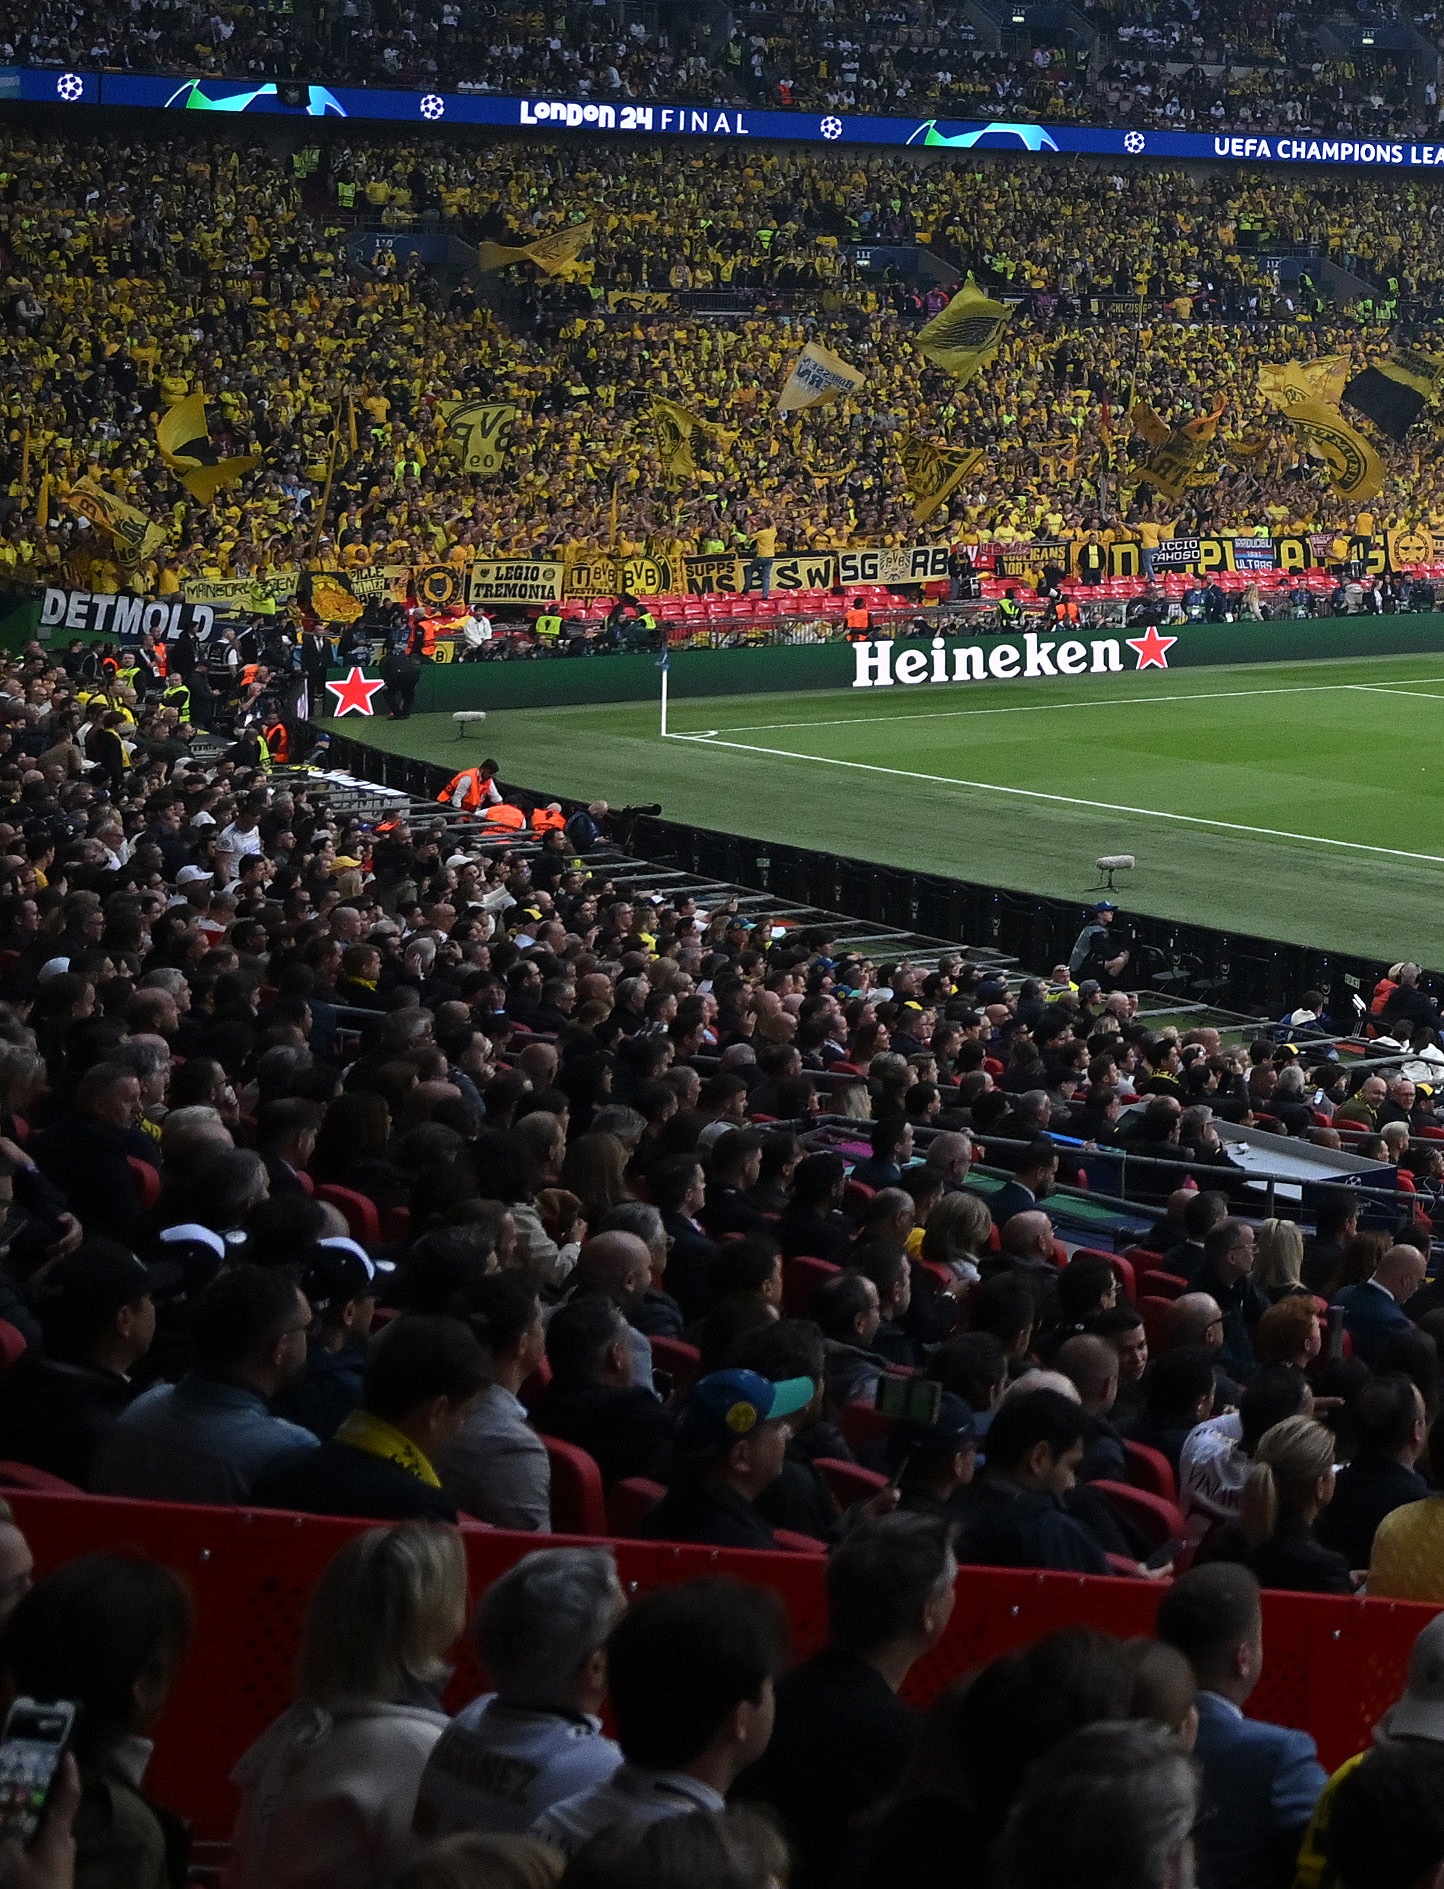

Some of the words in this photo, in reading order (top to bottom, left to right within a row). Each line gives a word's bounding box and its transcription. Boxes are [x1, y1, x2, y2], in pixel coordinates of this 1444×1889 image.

[521, 100, 615, 127] London
[619, 105, 654, 130] 24
[662, 110, 749, 134] FINAL
[1214, 137, 1272, 158] UEFA
[1277, 140, 1404, 165] CHAMPIONS
[686, 562, 735, 578] SUPPS
[841, 550, 879, 582] SG
[1151, 551, 1201, 563] FAMOSO
[495, 566, 539, 581] LEGIO
[623, 561, 656, 587] BVB
[686, 575, 736, 595] MS
[473, 583, 555, 600] TREMONIA
[41, 587, 214, 642] DETMOLD
[852, 632, 1124, 689] Heineken
